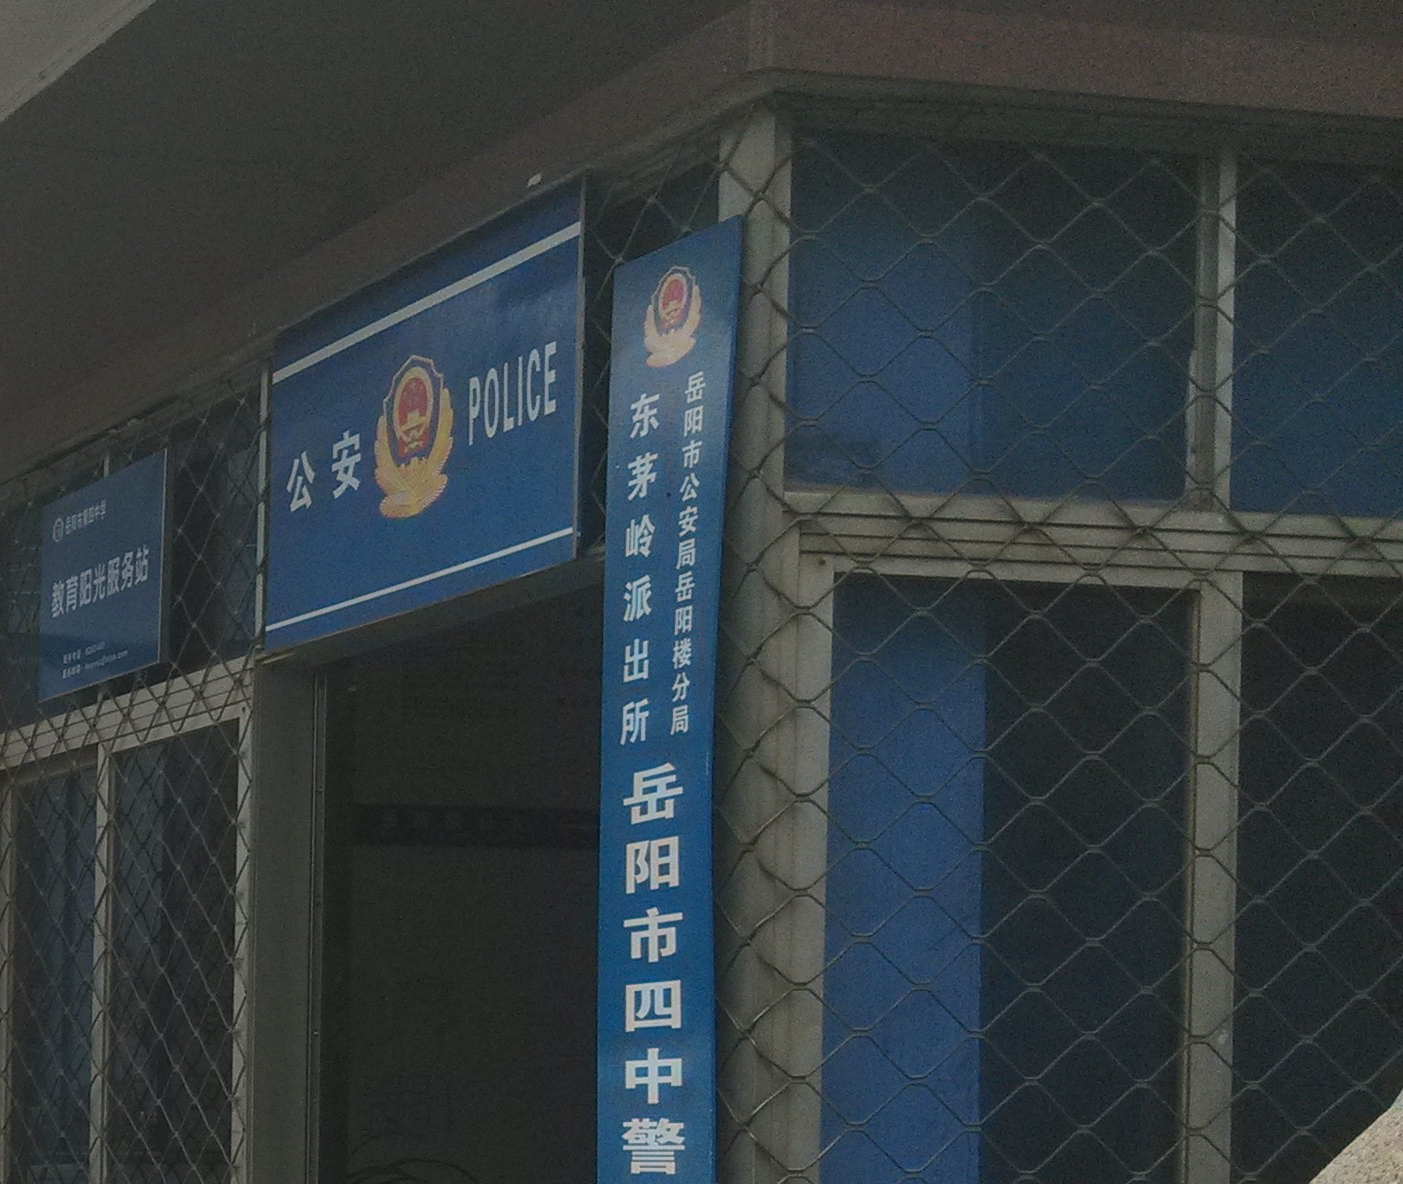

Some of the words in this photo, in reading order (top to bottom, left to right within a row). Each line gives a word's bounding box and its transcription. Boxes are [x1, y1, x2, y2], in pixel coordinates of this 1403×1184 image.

[468, 341, 559, 446] POLICE
[286, 430, 362, 513] 公安
[50, 546, 150, 619] 教育阳光服务站
[620, 393, 660, 747] 东茅岭派出所
[670, 371, 707, 737] 岳阳市公安局岳阳楼分局
